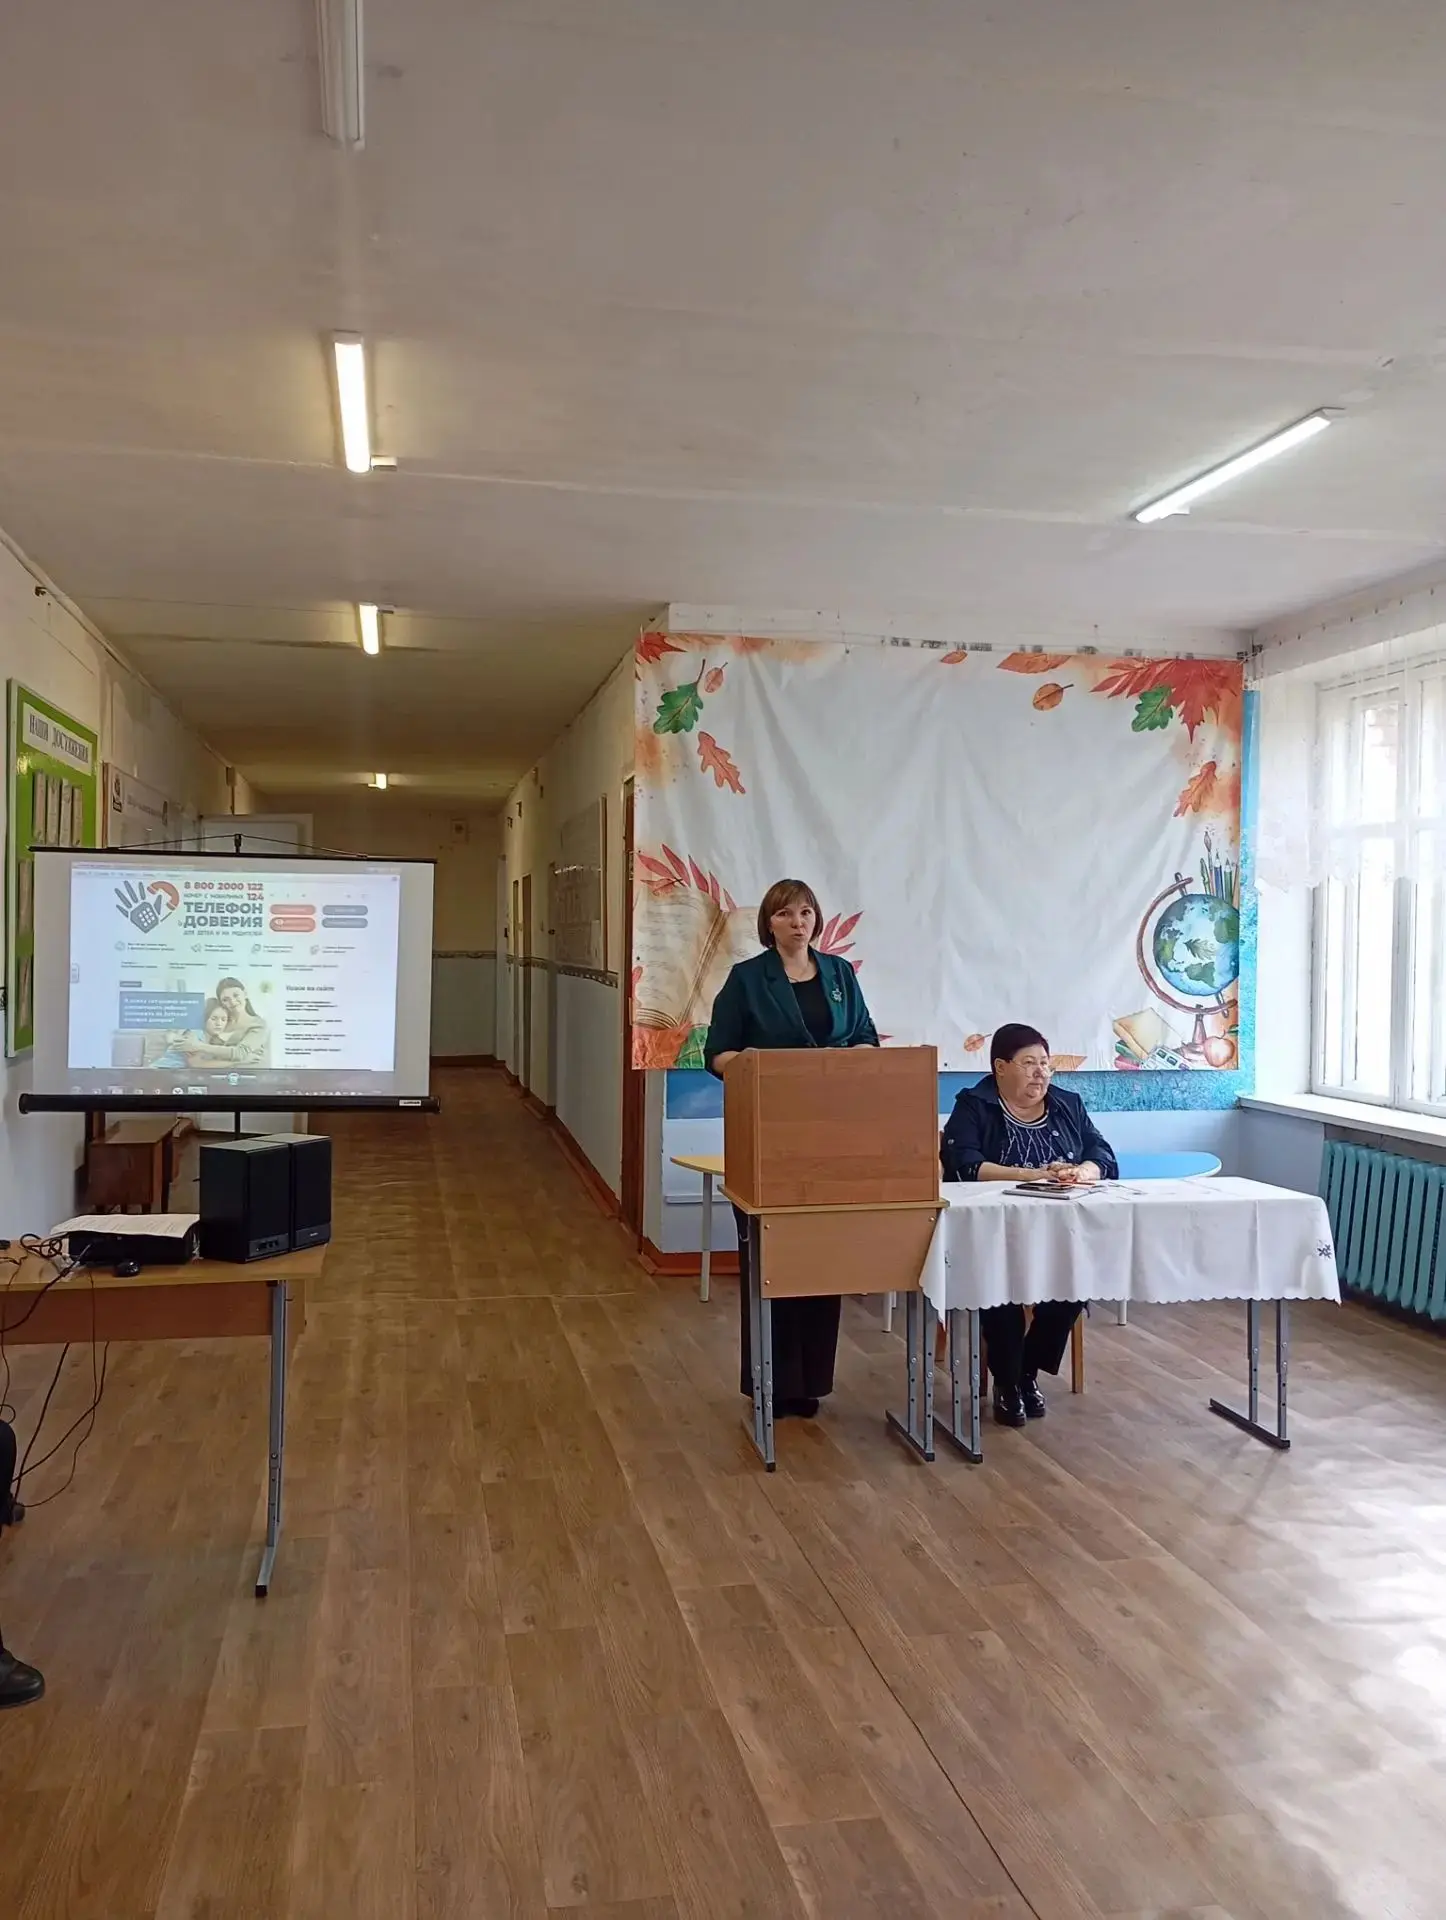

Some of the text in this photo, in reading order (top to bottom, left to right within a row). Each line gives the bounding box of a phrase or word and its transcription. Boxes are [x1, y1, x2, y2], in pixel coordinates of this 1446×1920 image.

[30, 713, 48, 742] НАШИ
[184, 881, 264, 891] 8 800 2000 122
[183, 901, 263, 914] ТЕЛЕФОН
[183, 915, 263, 928] ДОВЕРИЯ
